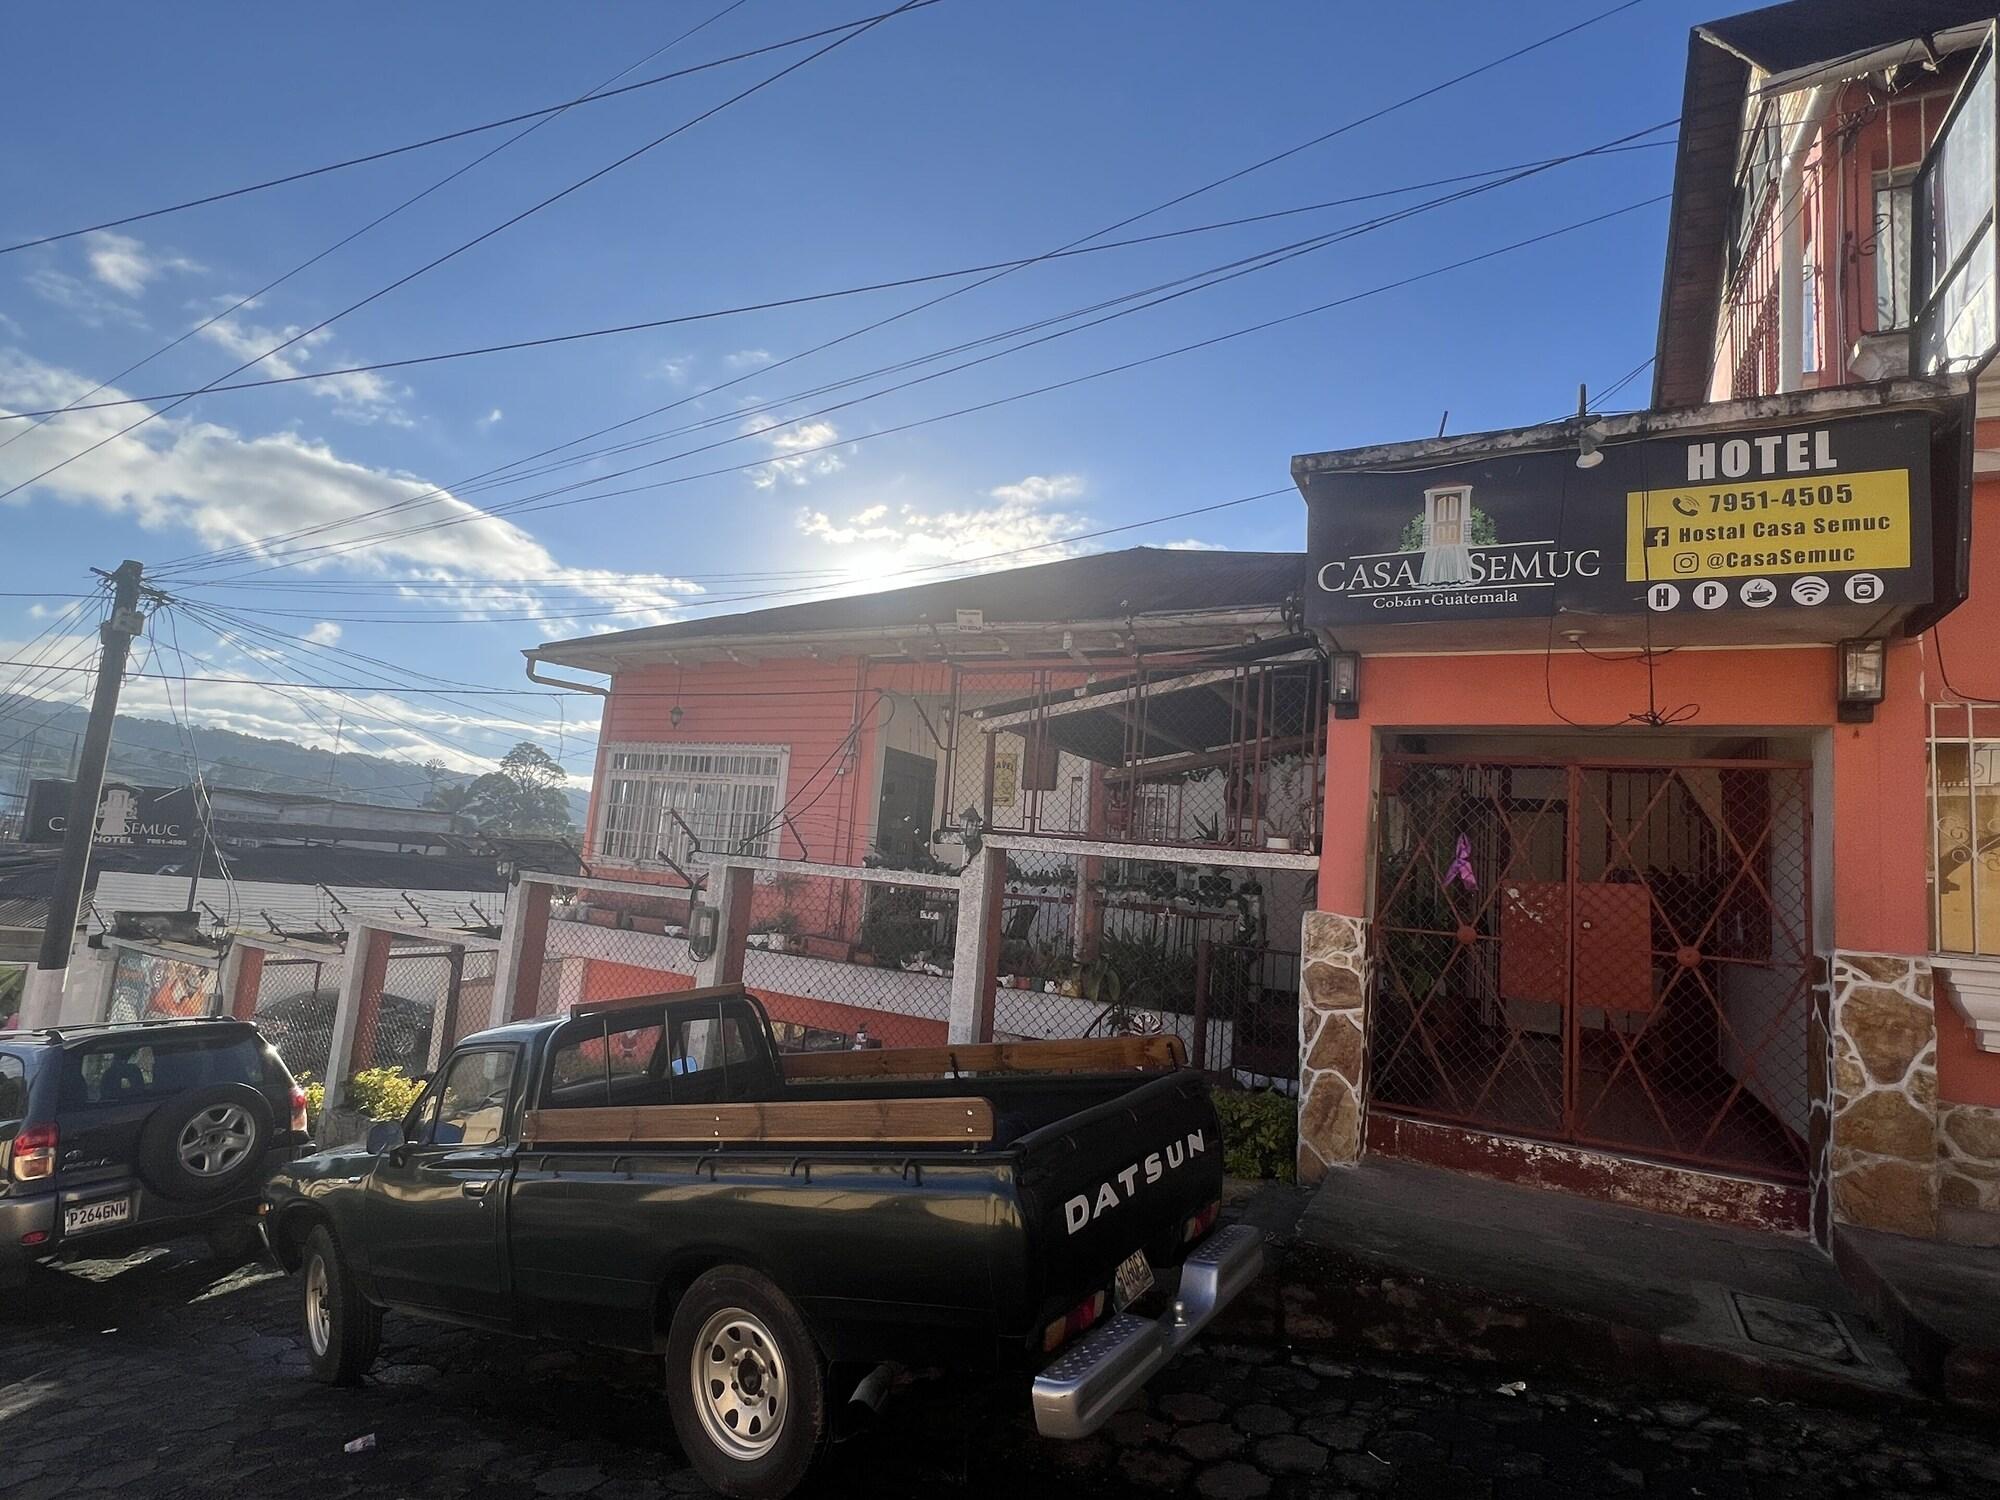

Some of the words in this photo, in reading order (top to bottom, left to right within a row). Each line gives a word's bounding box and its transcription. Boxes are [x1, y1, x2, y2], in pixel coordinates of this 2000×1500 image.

[1687, 430, 1837, 481] HOTEL
[1709, 484, 1852, 513] 7951-4505
[1679, 523, 1745, 543] Hostal
[1753, 519, 1806, 538] Casa
[1813, 516, 1890, 534] Semuc
[1317, 559, 1419, 592] CASA
[1469, 550, 1600, 582] SEMUC
[1706, 547, 1855, 569] @CasaSemuc
[1373, 595, 1421, 609] Cobán
[1431, 589, 1518, 607] Guatemala
[1065, 1129, 1205, 1235] DATSUN
